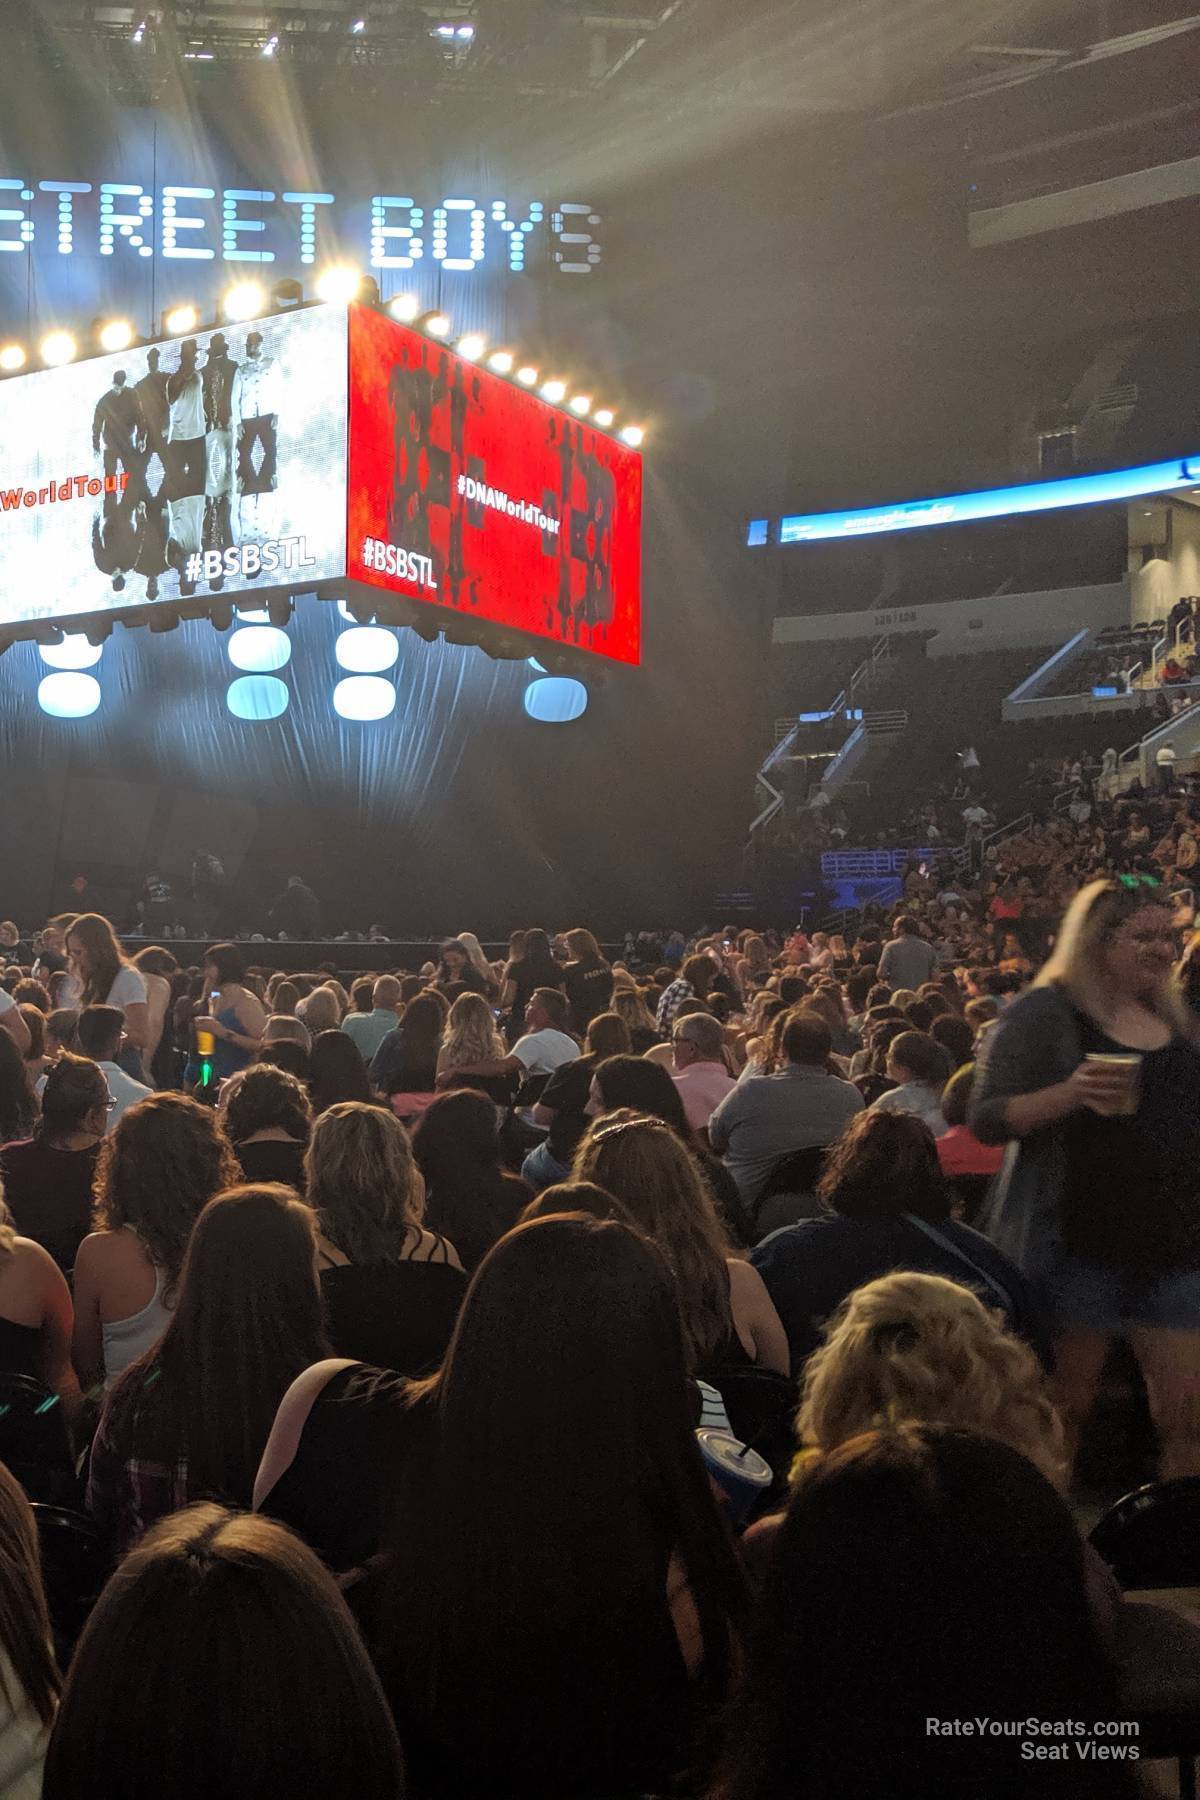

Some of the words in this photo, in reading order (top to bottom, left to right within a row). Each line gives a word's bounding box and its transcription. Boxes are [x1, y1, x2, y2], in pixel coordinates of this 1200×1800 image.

[370, 197, 600, 272] BOYS
[457, 475, 560, 534] #DNAWorldTour
[186, 536, 315, 582] #BSBSTL
[362, 536, 437, 588] #BSBSTL
